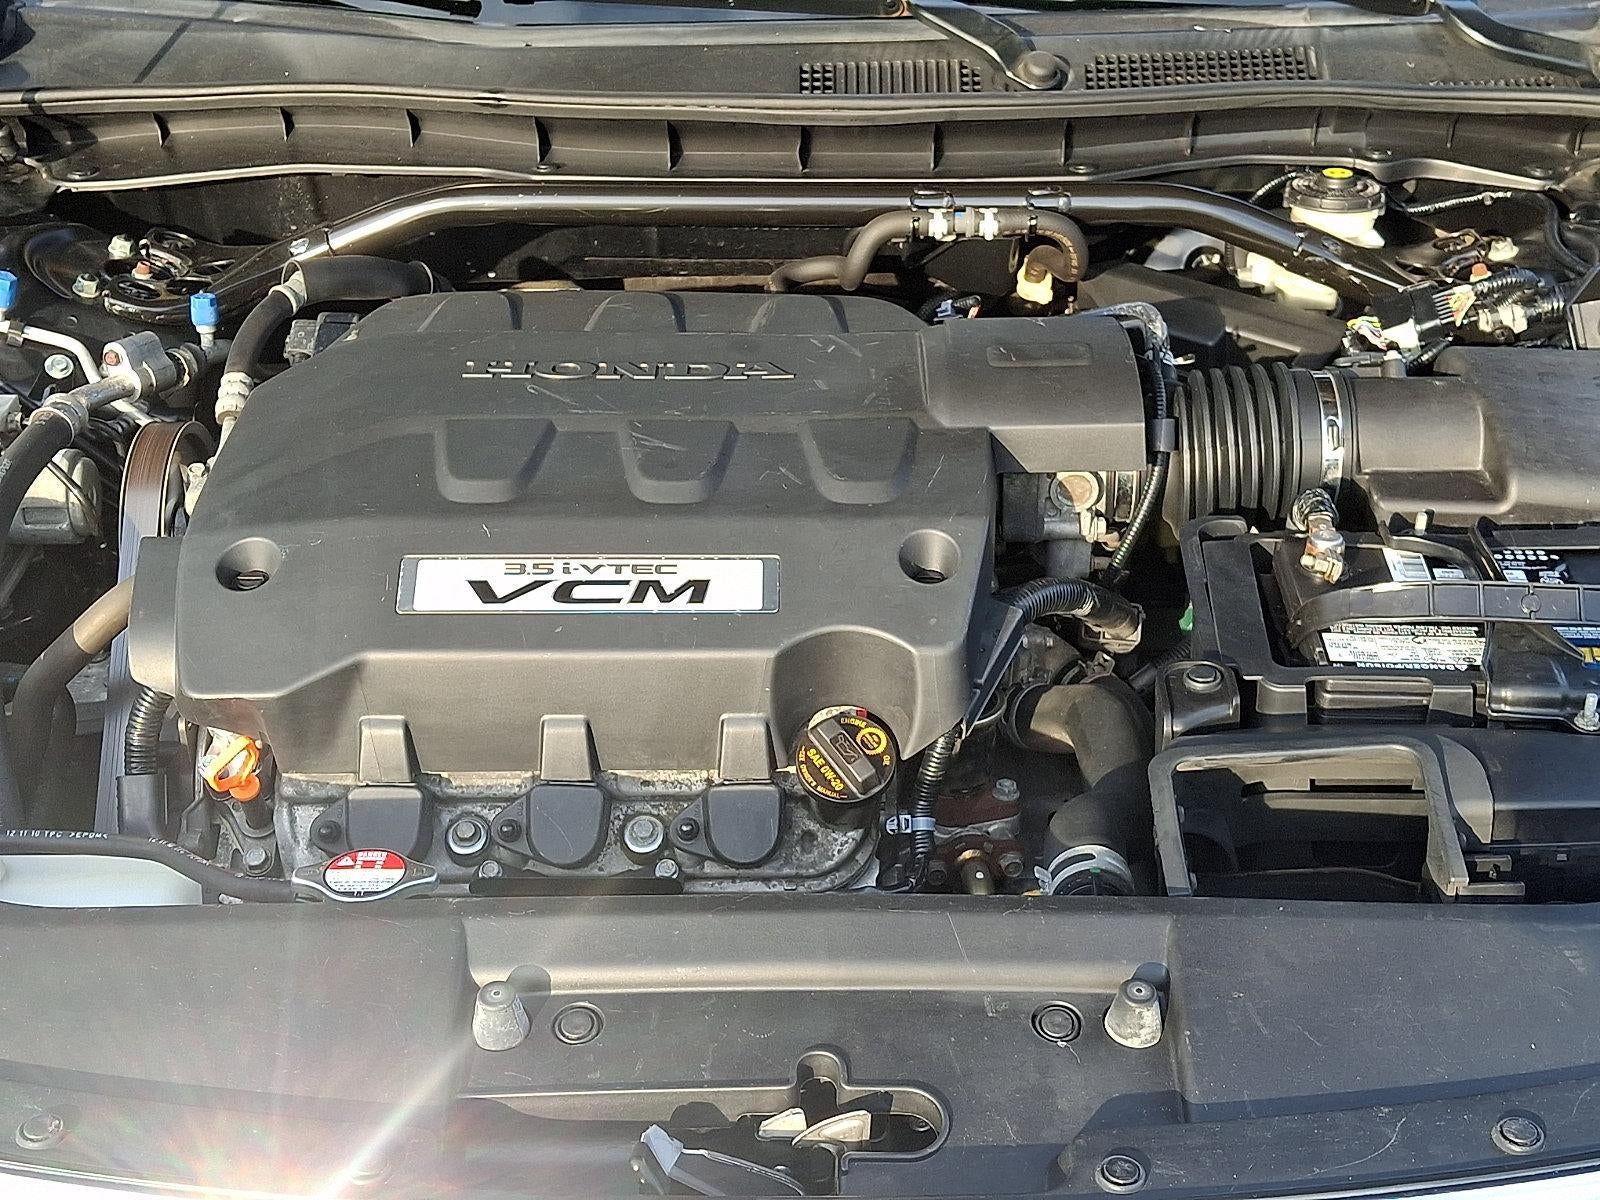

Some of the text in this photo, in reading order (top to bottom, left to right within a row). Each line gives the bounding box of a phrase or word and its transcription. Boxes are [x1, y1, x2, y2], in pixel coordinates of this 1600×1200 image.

[462, 361, 797, 380] HONDA
[503, 562, 678, 576] 3.5 i-VTEC
[466, 579, 711, 605] VCM
[806, 748, 844, 791] SAE 0W-20
[6, 829, 15, 837] 12
[19, 829, 28, 837] 11
